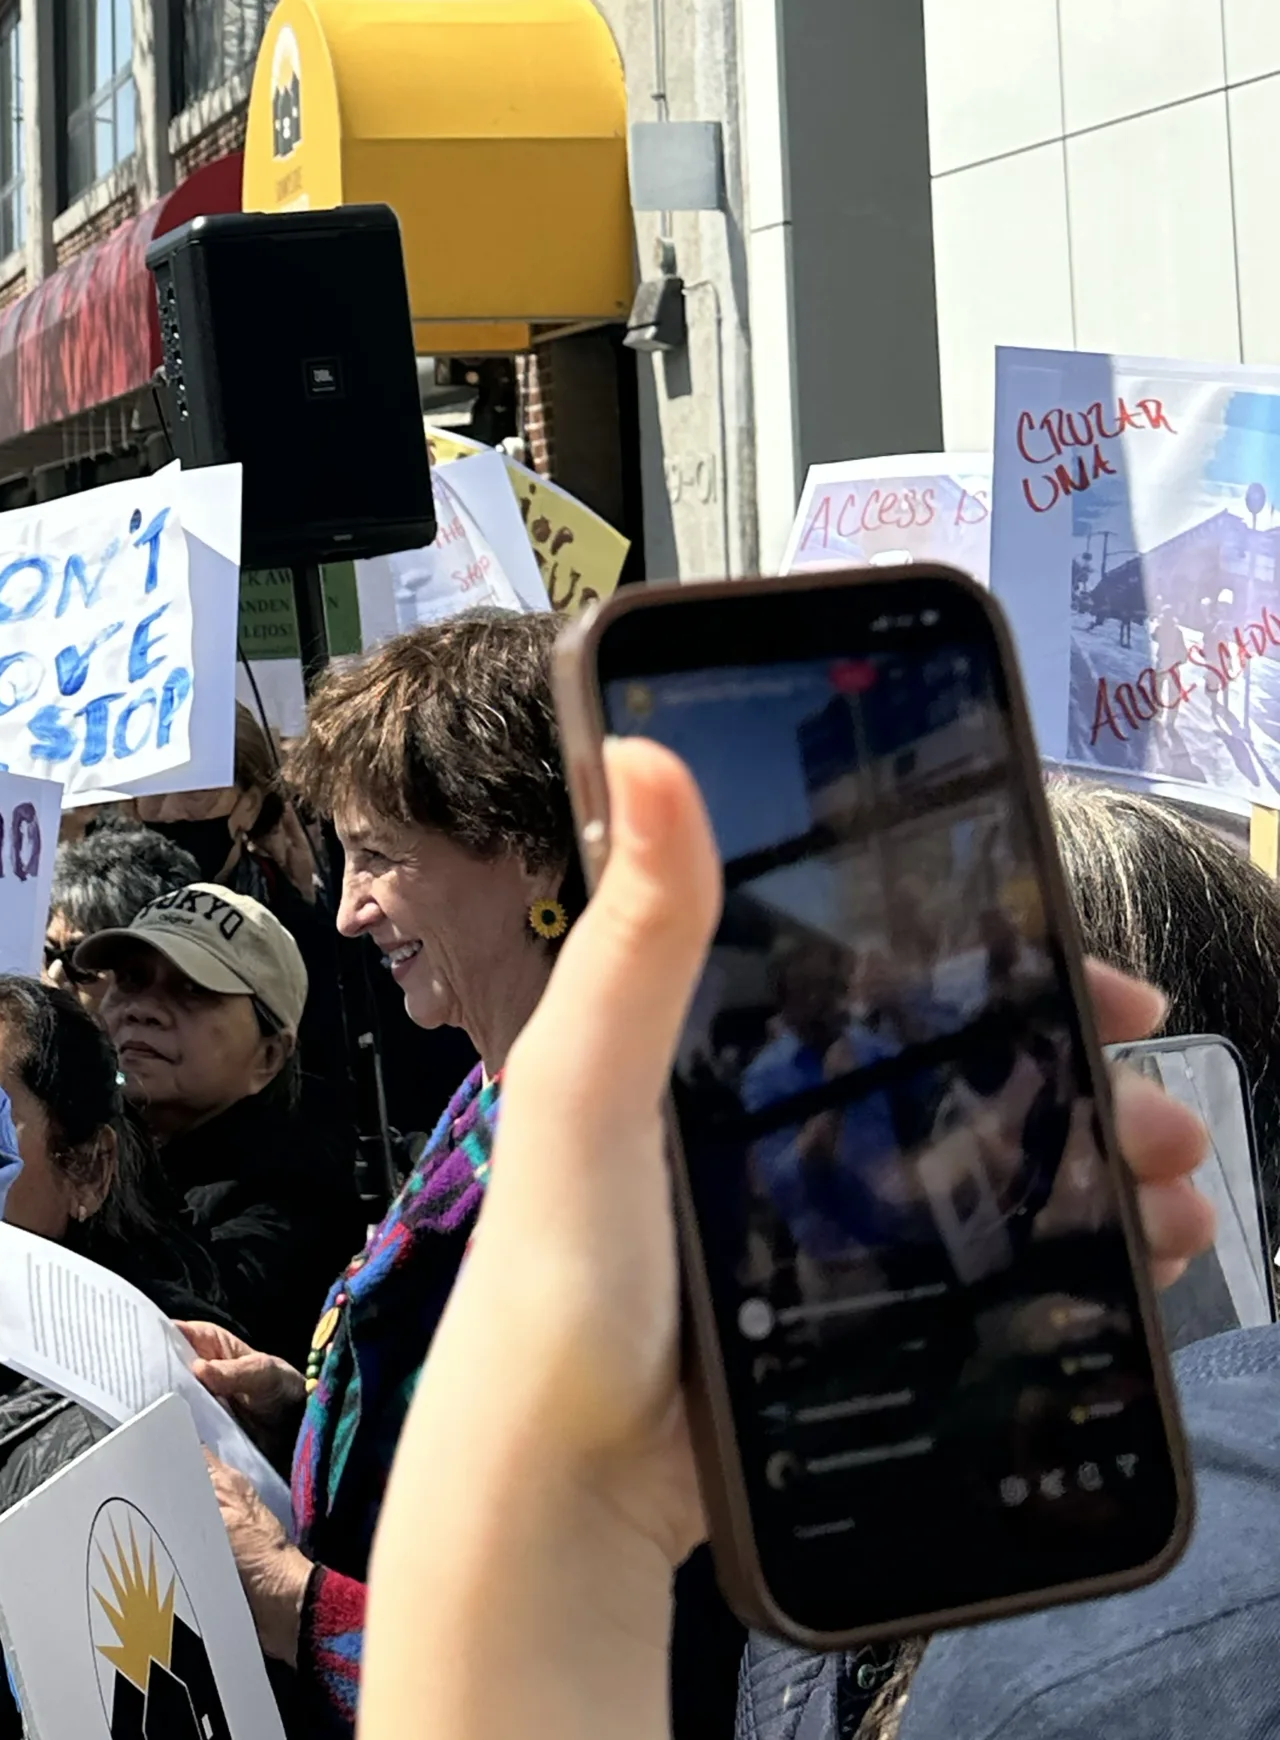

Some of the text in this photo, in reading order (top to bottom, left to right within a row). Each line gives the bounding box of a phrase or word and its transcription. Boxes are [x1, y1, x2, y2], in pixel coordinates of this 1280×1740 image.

[1022, 444, 1117, 513] UNA
[238, 597, 291, 614] NDEN
[26, 666, 192, 767] STOP
